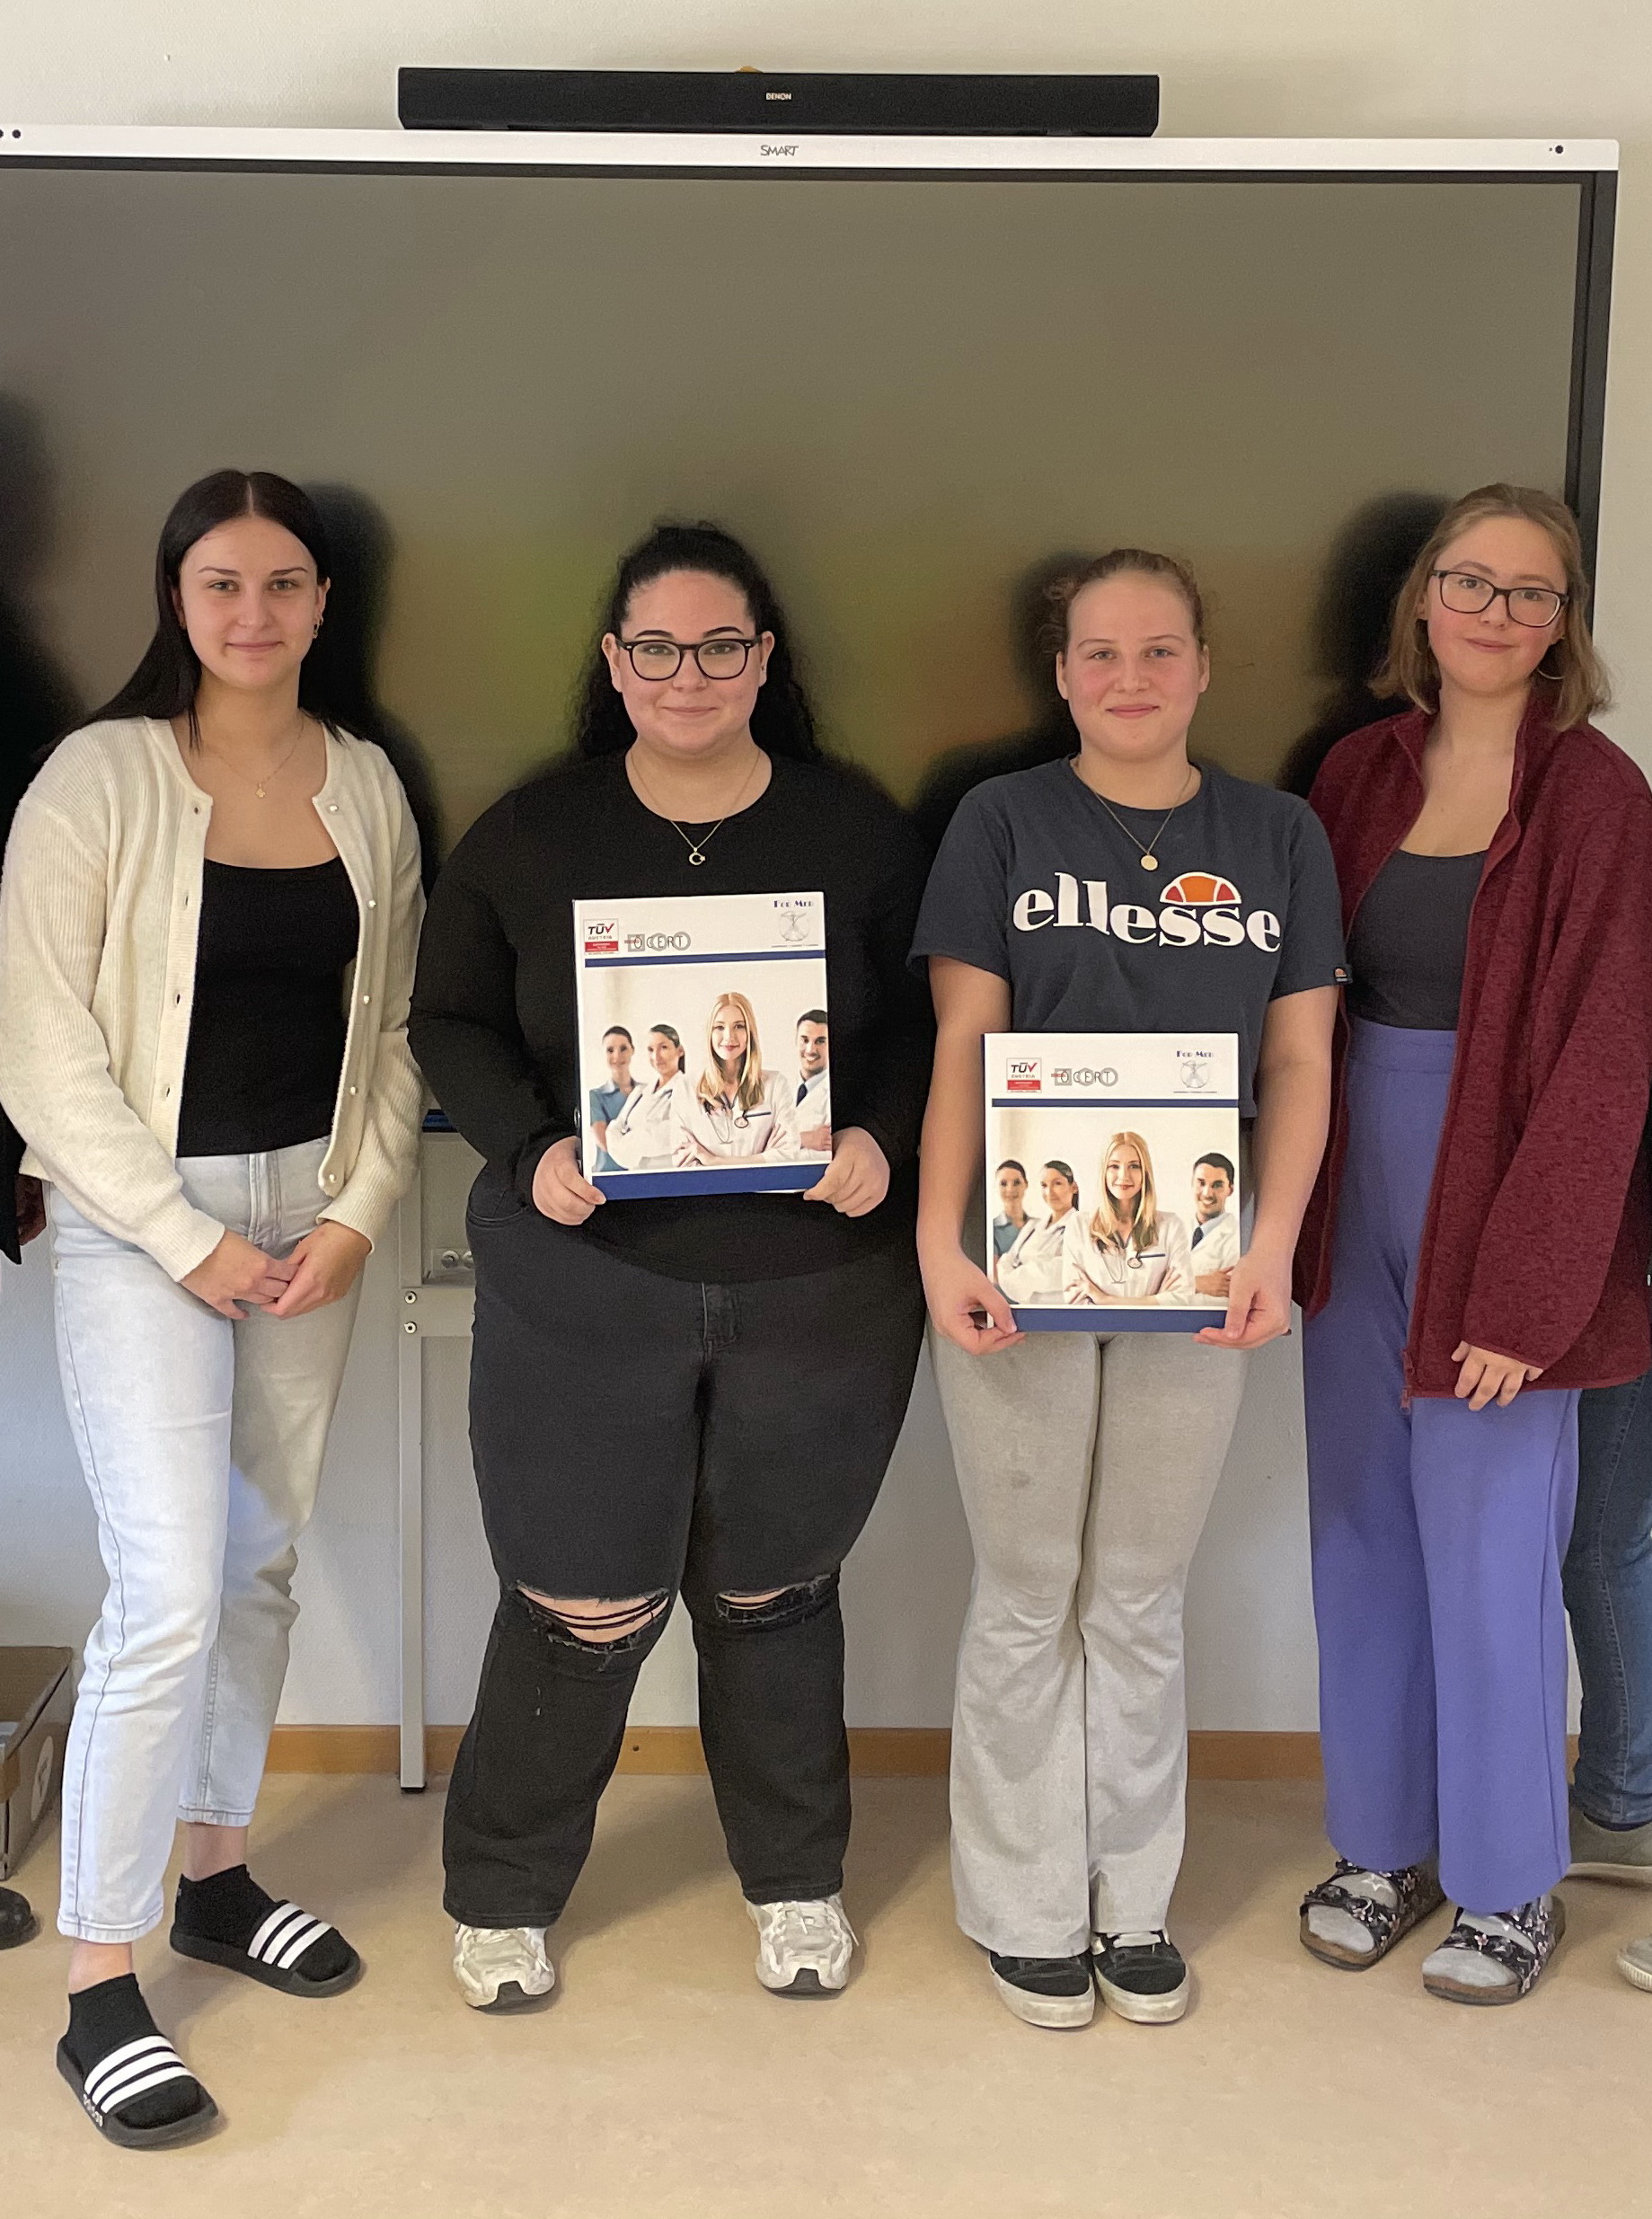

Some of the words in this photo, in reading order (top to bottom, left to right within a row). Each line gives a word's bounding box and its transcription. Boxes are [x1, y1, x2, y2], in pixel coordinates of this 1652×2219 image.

[760, 145, 799, 156] SMART
[1012, 871, 1281, 952] ellesse
[587, 923, 614, 934] TÜV
[1011, 1062, 1038, 1074] TÜV
